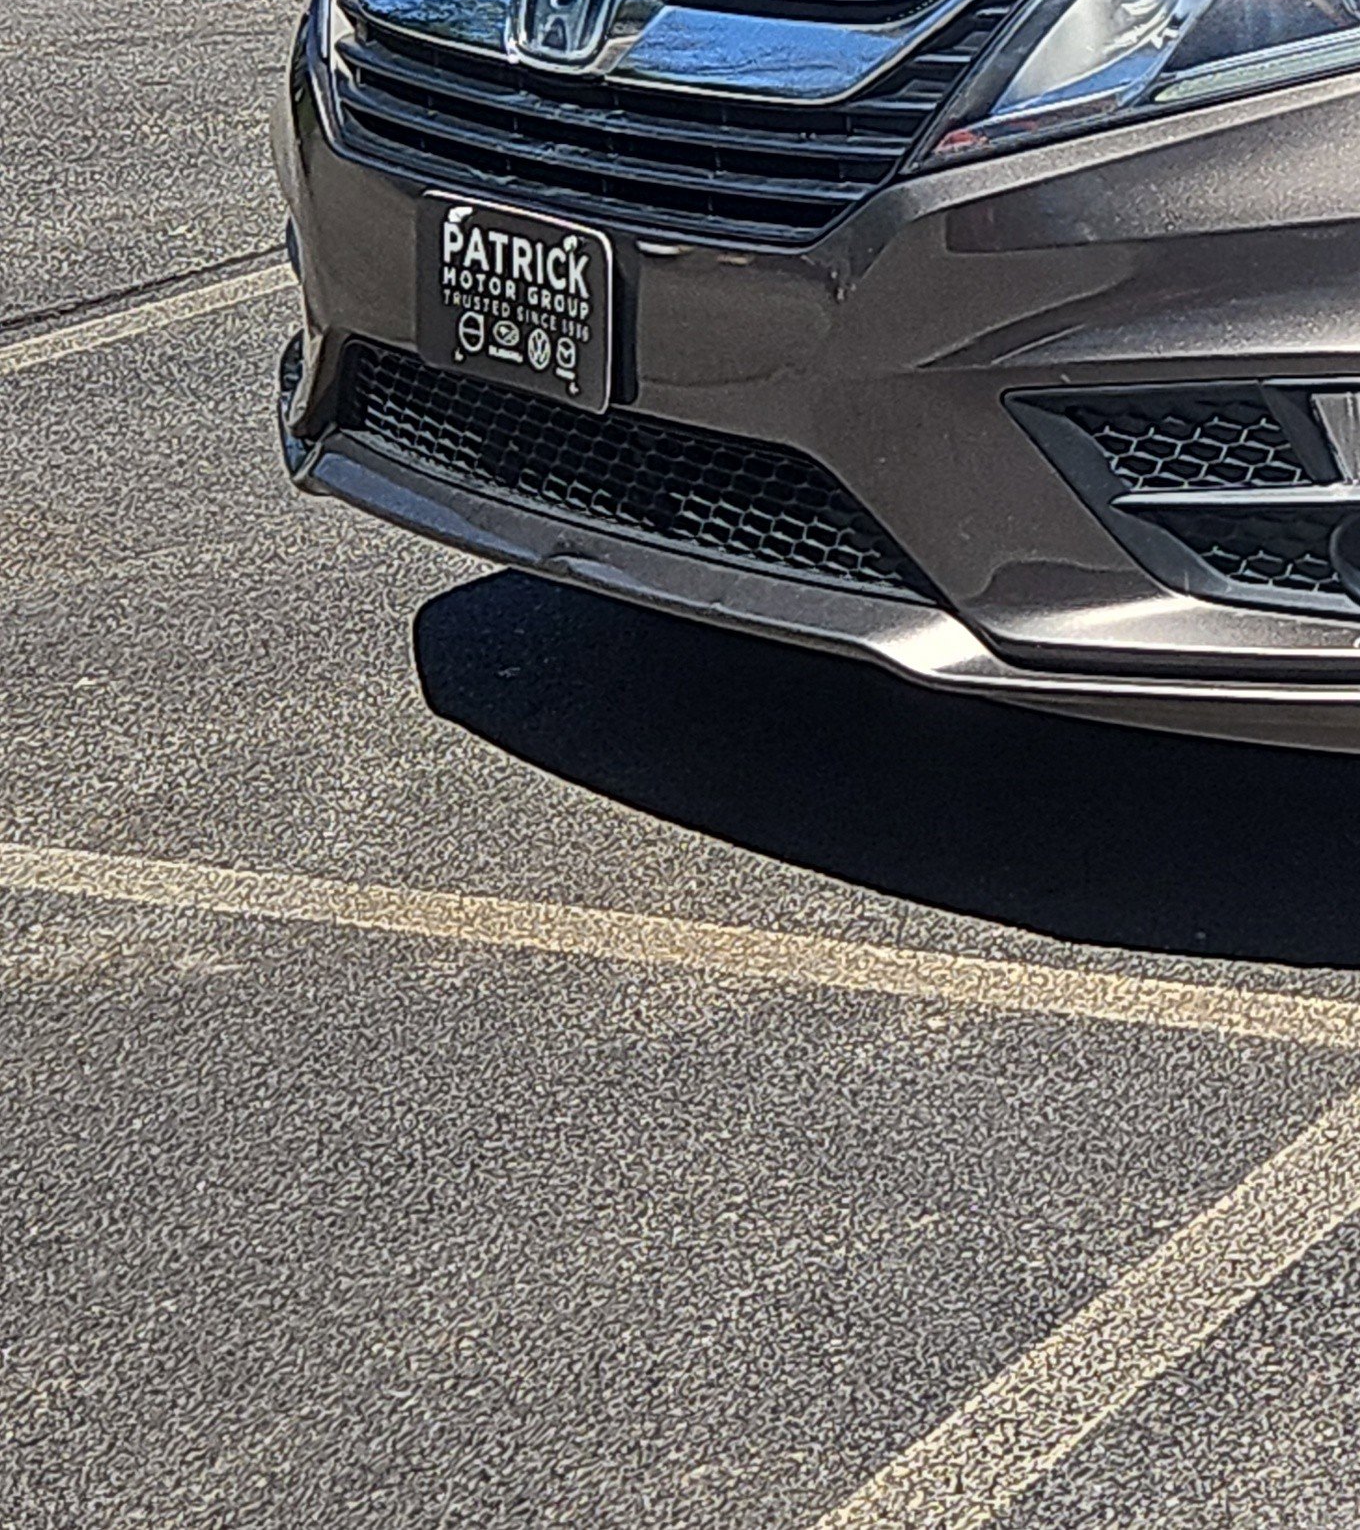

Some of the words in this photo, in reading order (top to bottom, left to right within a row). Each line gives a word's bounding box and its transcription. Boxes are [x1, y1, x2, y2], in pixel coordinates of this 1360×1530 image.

[444, 221, 589, 299] PATRICK
[442, 266, 516, 301] MOTOR
[527, 286, 590, 320] GROUP
[443, 289, 511, 318] TRUSTED
[516, 305, 558, 331] SINCE
